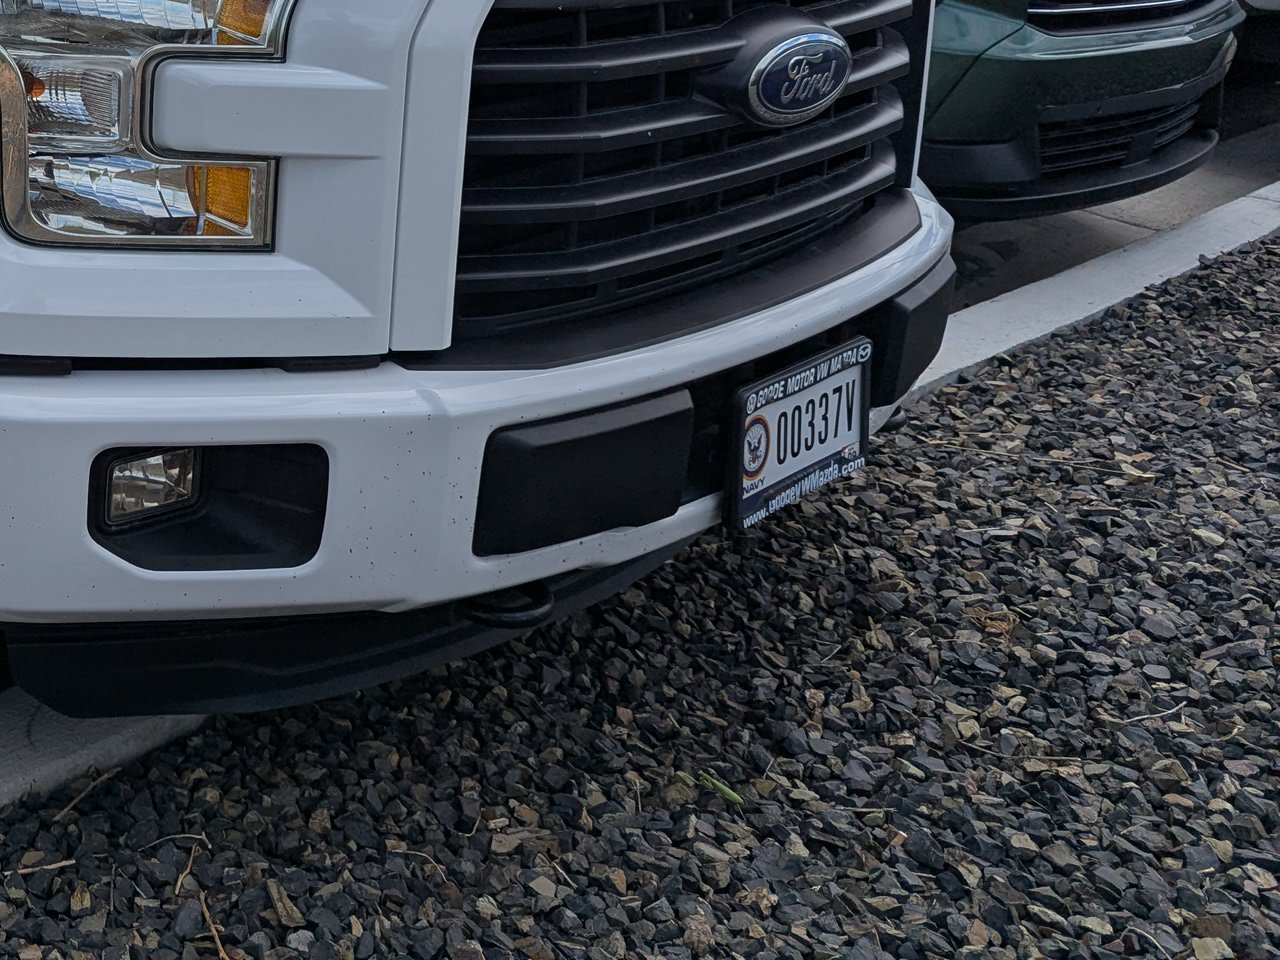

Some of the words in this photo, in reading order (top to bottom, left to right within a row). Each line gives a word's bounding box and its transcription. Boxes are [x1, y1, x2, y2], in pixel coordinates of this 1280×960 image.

[780, 52, 837, 104] Ford
[757, 381, 784, 407] GOODE
[786, 368, 815, 394] MOTOR
[817, 361, 830, 381] VW
[830, 348, 857, 375] MAZDA
[776, 379, 856, 466] 00337V
[743, 476, 765, 494] NAVY
